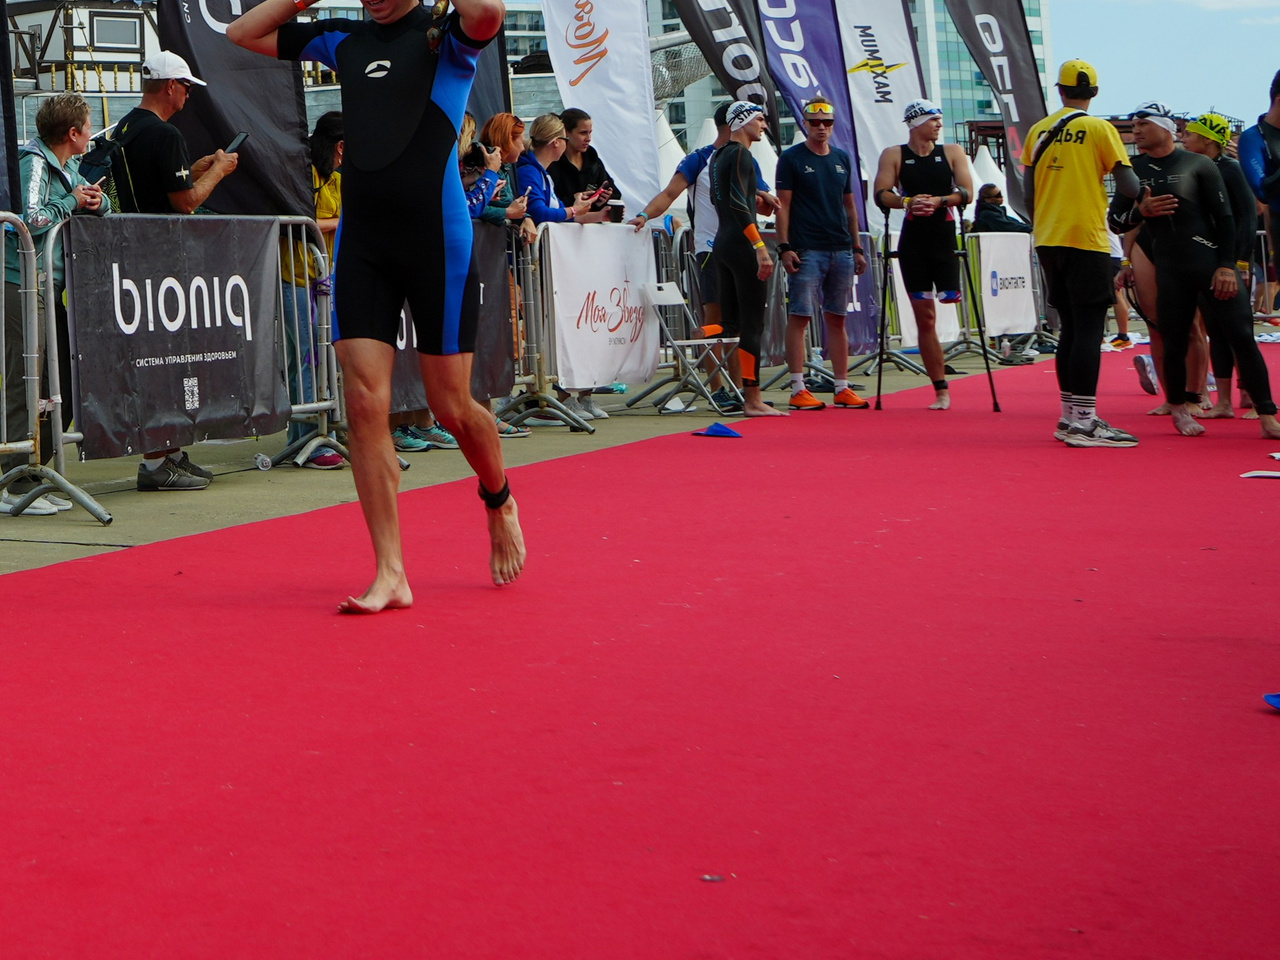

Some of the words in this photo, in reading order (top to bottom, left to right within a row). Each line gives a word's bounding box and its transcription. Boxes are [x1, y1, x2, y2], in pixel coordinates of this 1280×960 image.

[112, 262, 253, 341] bioniq
[135, 356, 165, 368] СИСТЕМА
[165, 353, 204, 365] УПРАВЛЕНИЯ
[203, 350, 237, 362] ЗДОРОВЬЕМ
